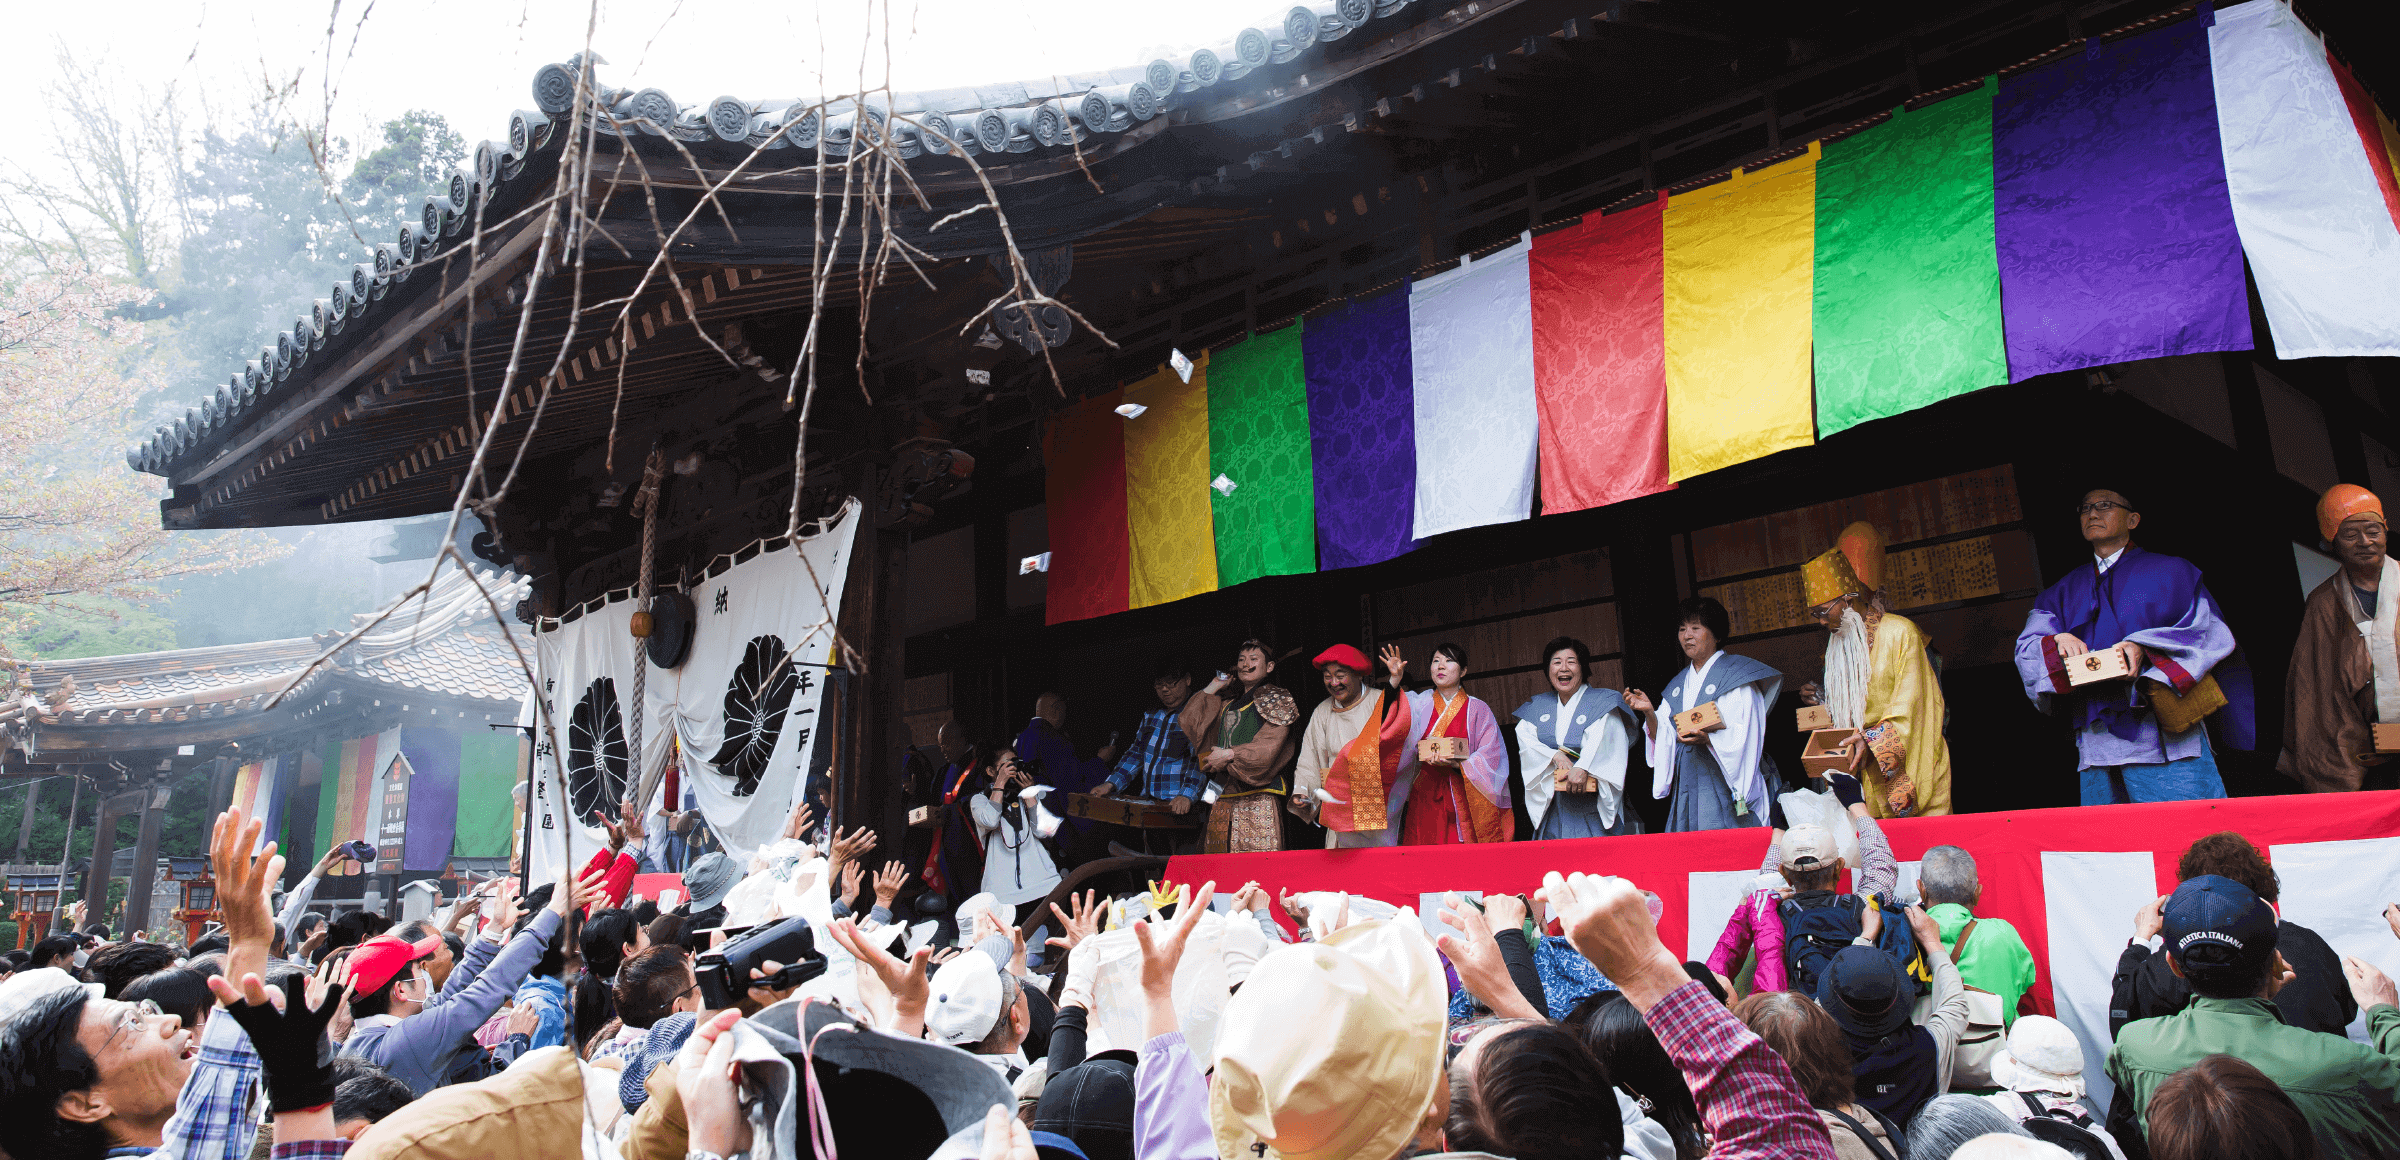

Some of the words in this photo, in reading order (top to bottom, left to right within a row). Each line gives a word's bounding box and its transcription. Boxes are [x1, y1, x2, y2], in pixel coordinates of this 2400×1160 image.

[713, 585, 729, 616] 納
[2178, 931, 2207, 949] ATLETICA
[2208, 931, 2244, 949] ITALIANA
